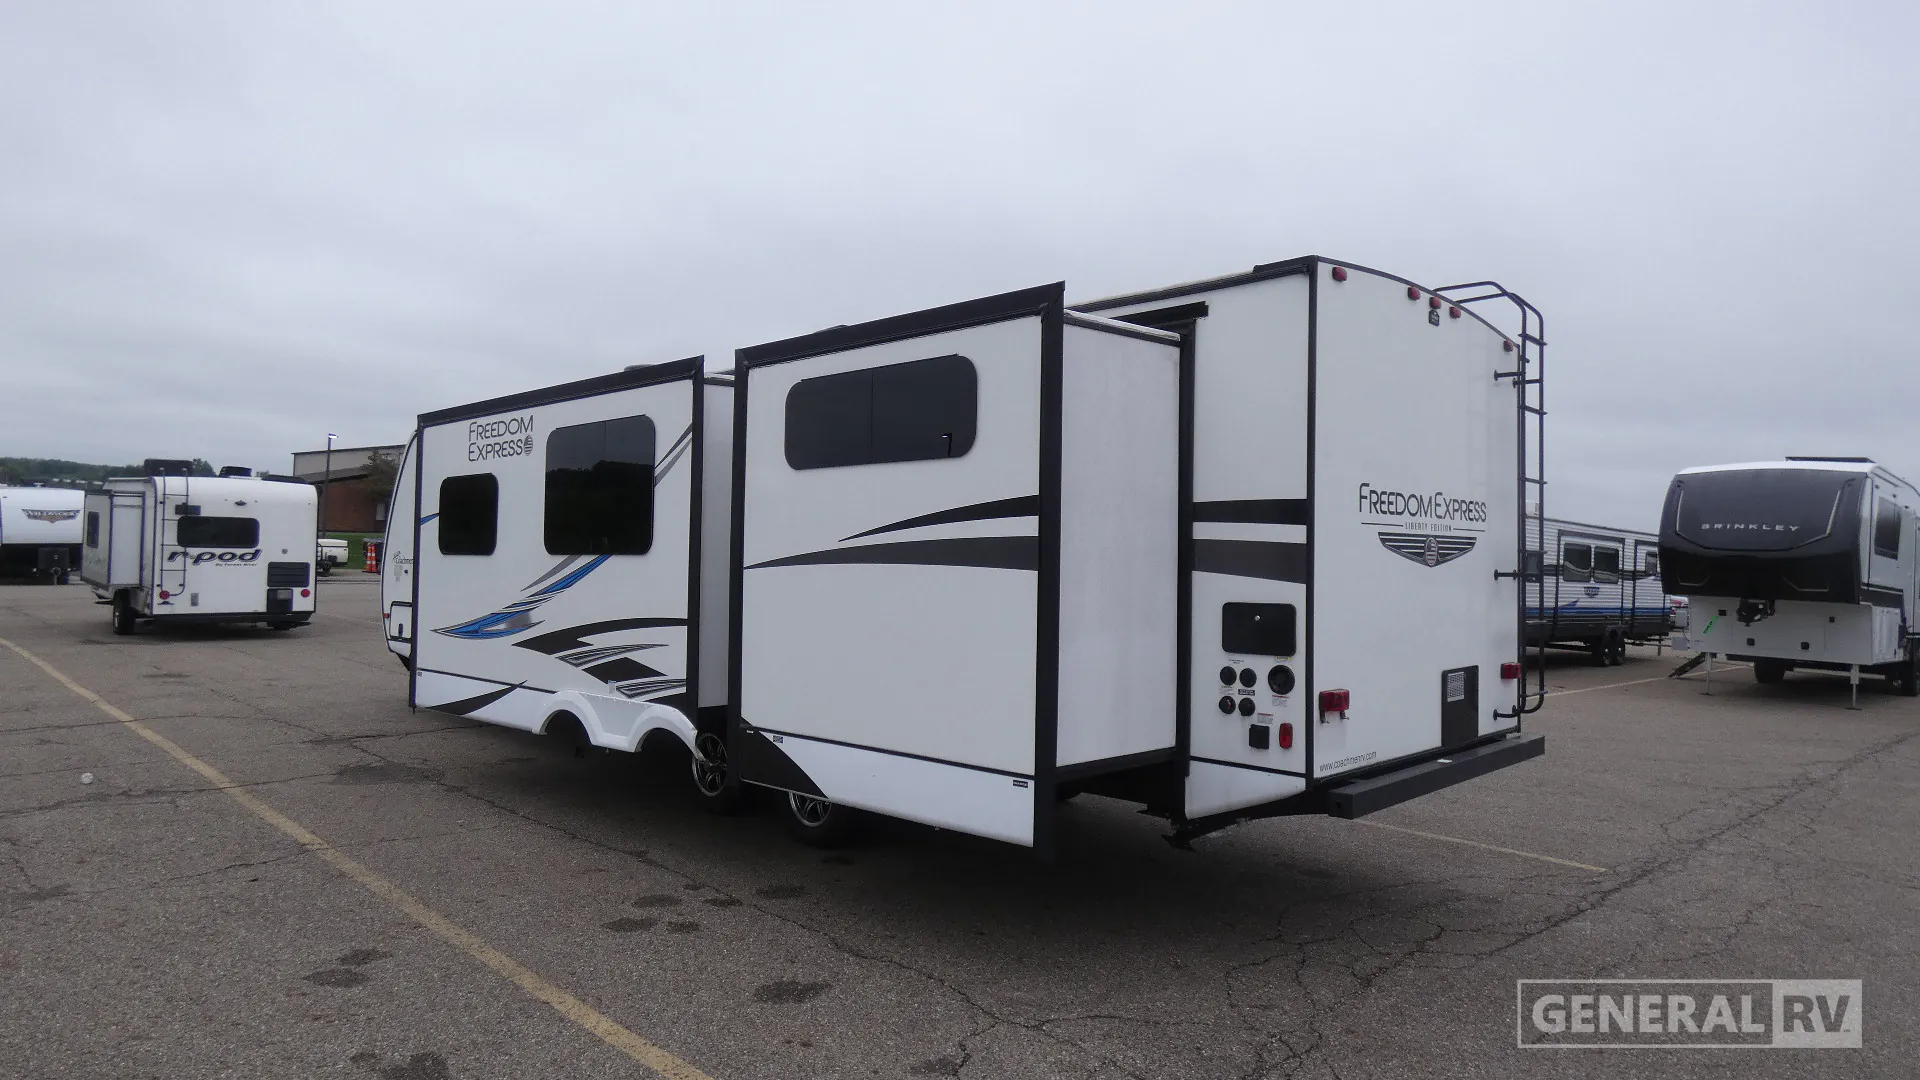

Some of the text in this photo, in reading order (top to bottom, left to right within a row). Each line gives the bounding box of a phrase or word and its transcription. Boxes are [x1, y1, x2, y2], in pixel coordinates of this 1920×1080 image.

[469, 415, 533, 441] FREEDOM
[469, 438, 523, 462] EXPRESS
[1359, 483, 1487, 522] FREEDOM EXPRESS
[1404, 522, 1452, 532] LIBERTY EDITION
[1701, 523, 1799, 532] BRINKLEY
